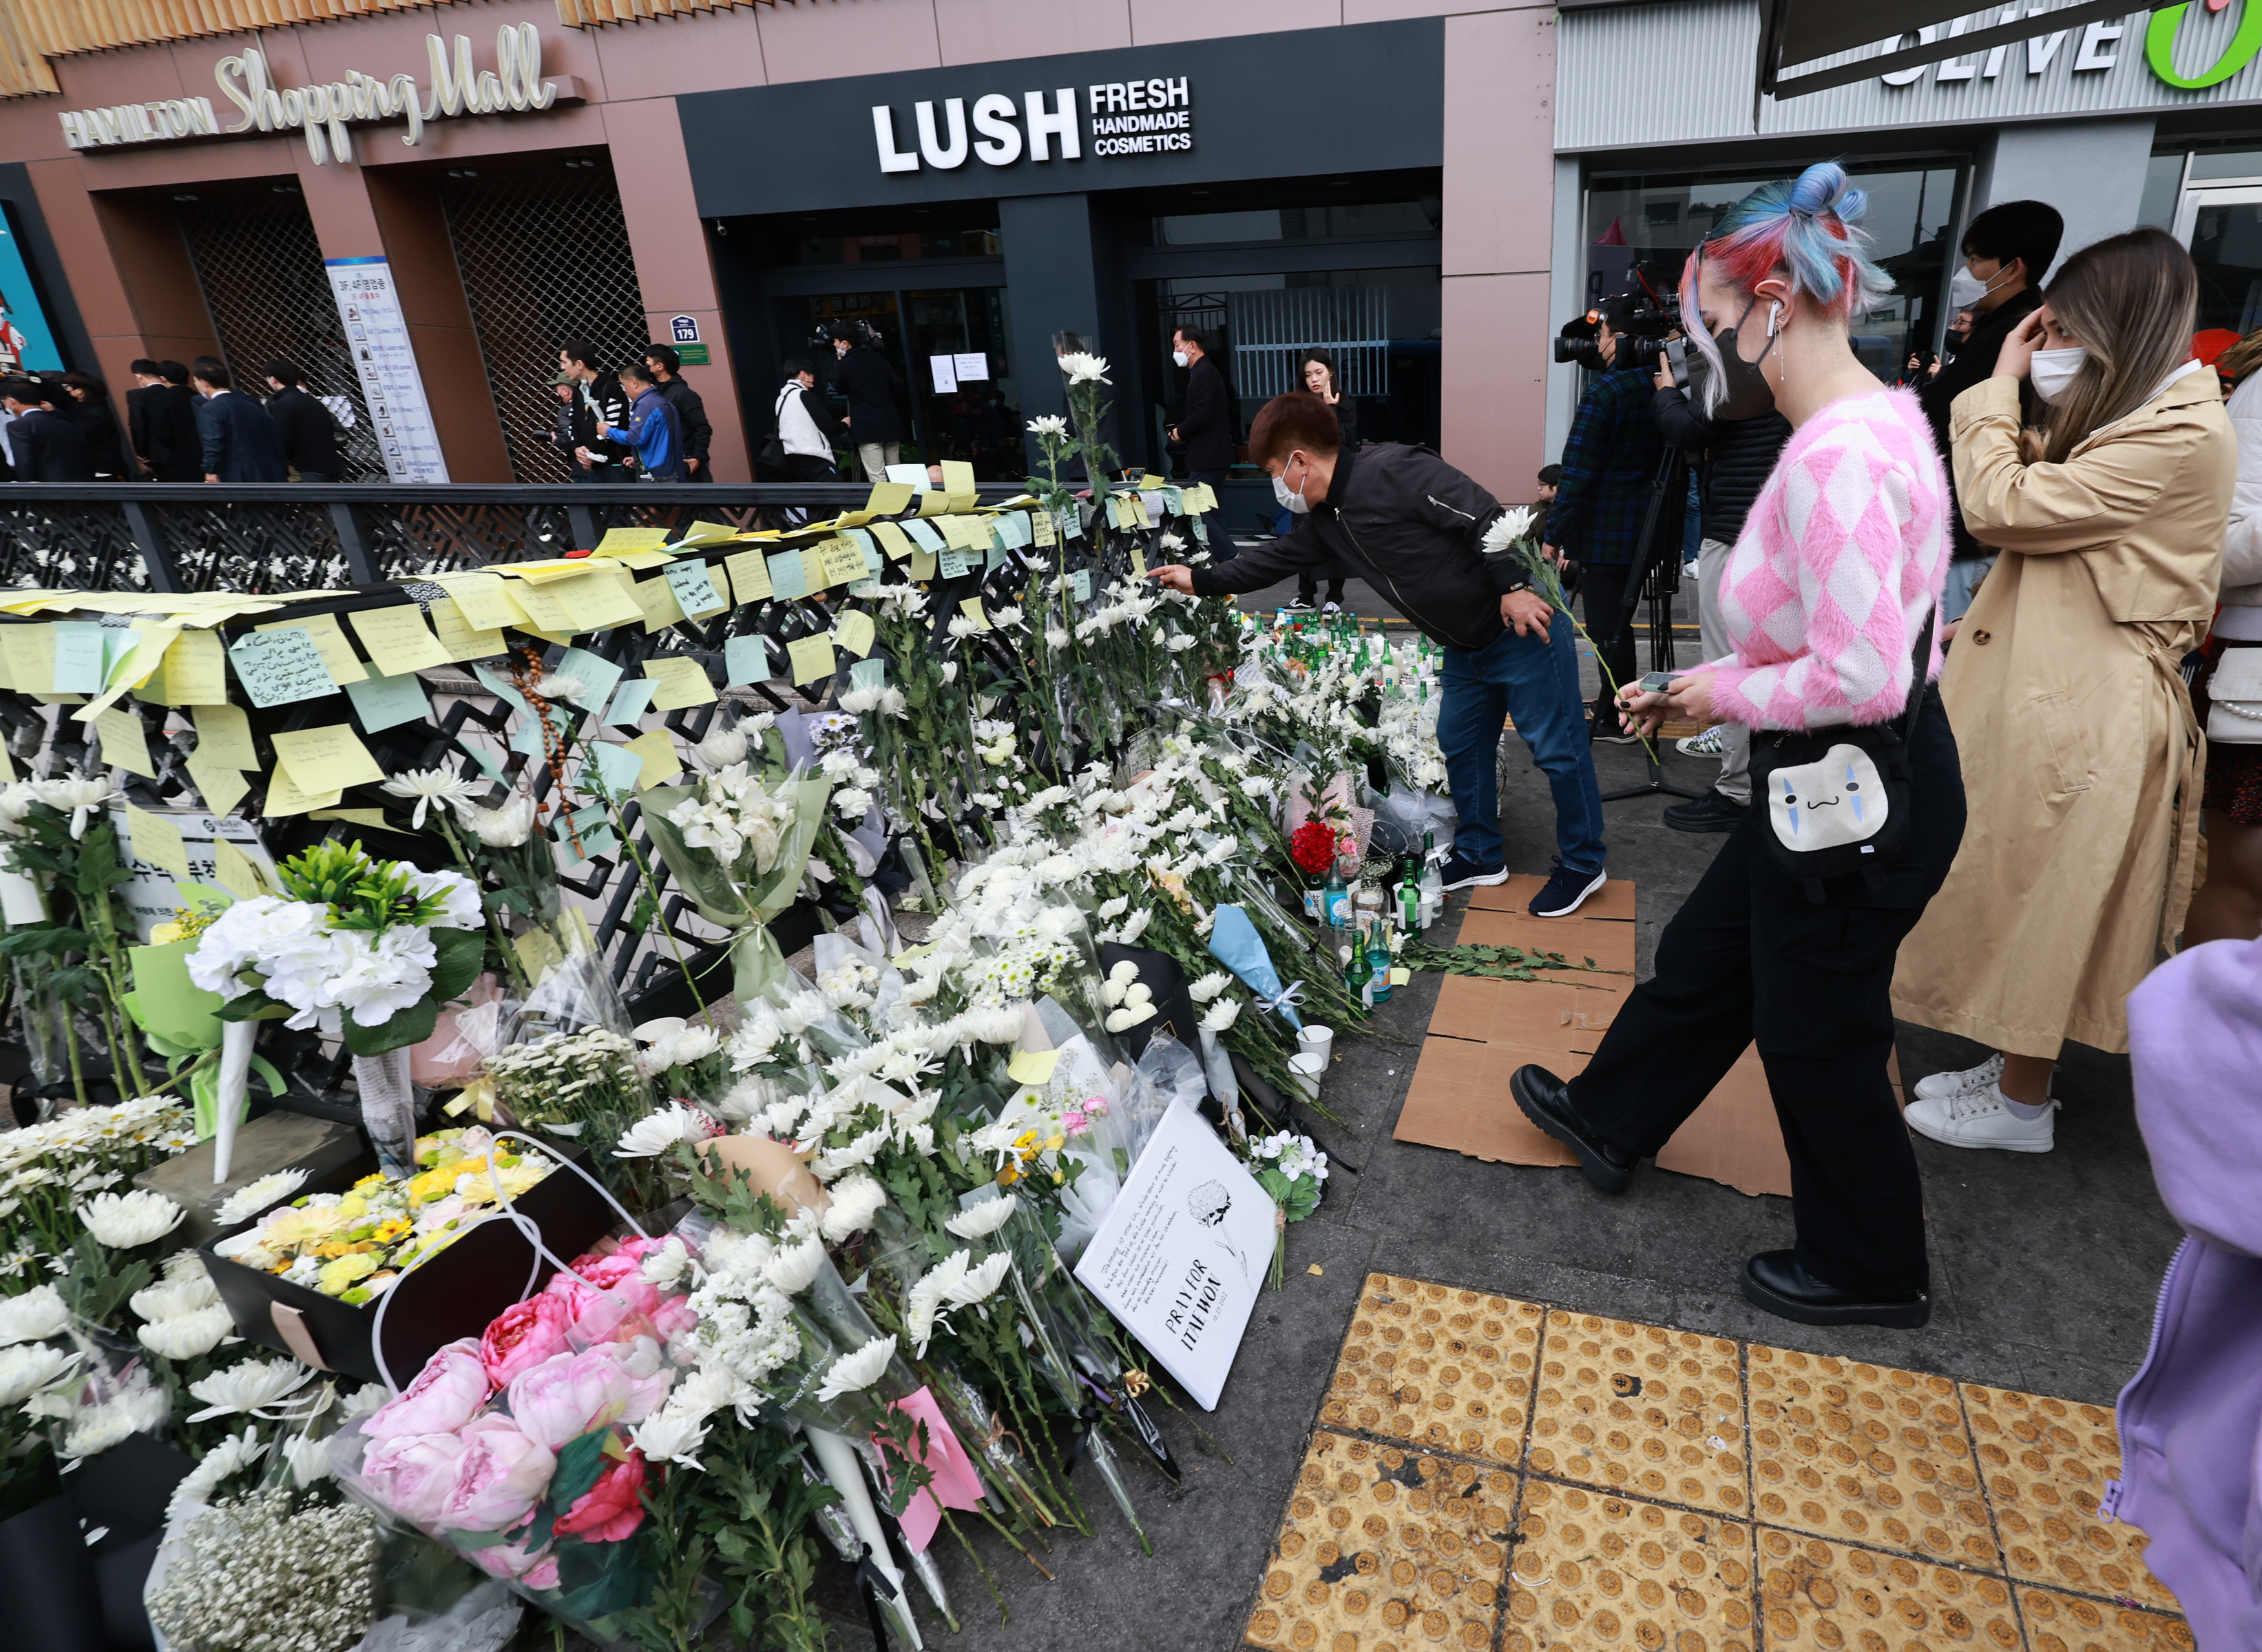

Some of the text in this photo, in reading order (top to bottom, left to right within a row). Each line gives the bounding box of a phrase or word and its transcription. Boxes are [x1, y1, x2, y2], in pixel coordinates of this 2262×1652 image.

[59, 21, 557, 166] HAMILTON Shopping Mall
[1089, 76, 1190, 114] FRESH
[872, 87, 1081, 173] LUSH
[1093, 111, 1191, 136] HANDMADE
[1095, 132, 1192, 156] COSMETICS
[677, 328, 694, 339] 179
[1165, 1259, 1208, 1334] PRAY FOR
[1181, 1273, 1222, 1351] ITAEWON
[779, 1388, 805, 1412] Flower
[799, 1372, 813, 1388] Art
